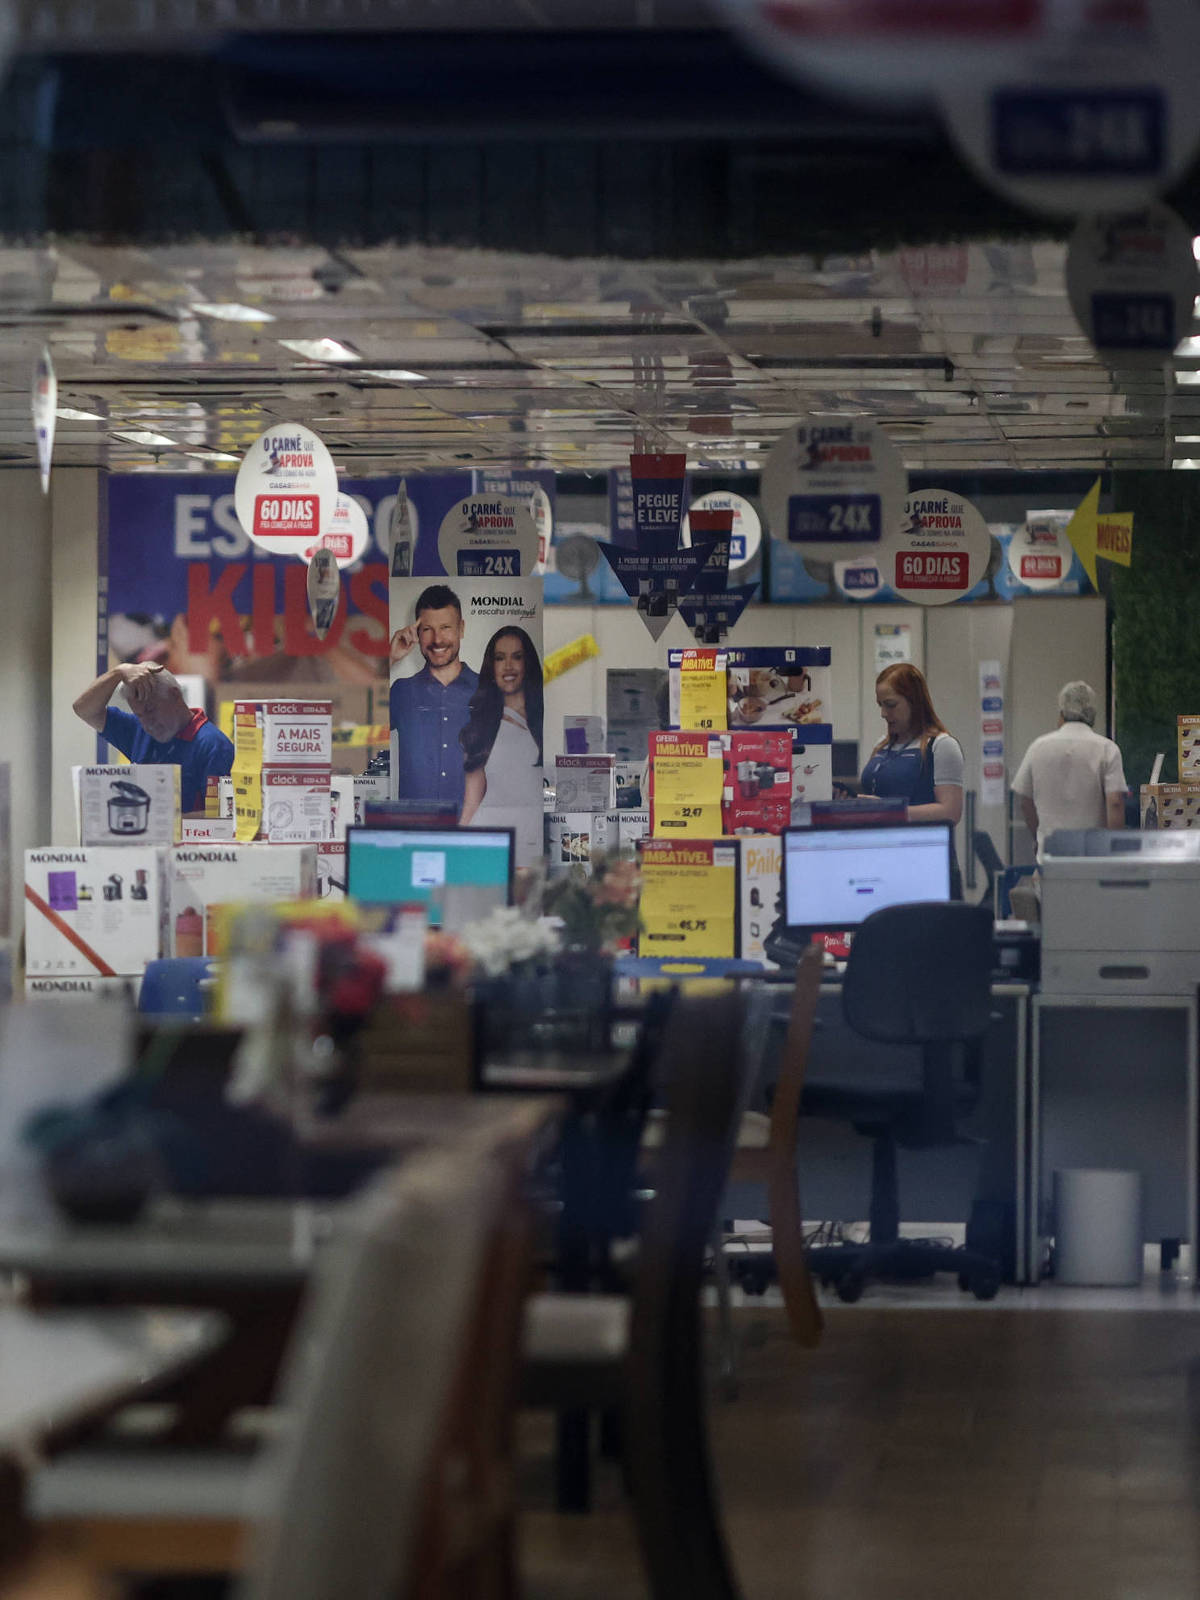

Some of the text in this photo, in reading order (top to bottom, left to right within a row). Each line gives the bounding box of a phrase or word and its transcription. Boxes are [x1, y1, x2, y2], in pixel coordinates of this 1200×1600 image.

[263, 437, 270, 452] O
[272, 433, 302, 452] CARNÊ
[279, 454, 313, 468] APROVA
[462, 503, 469, 515] O
[471, 500, 502, 515] CARNÊ
[637, 494, 679, 508] PEGUE
[913, 498, 949, 514] CARNÊ
[950, 505, 965, 514] QUE
[260, 500, 280, 520] 60
[281, 500, 313, 520] DIAS
[637, 509, 679, 523] E LEVE
[478, 516, 514, 528] APROVA
[829, 504, 872, 532] 24X
[921, 515, 962, 529] APROVA
[485, 556, 515, 575] 24X
[902, 556, 961, 574] 60 DIAS
[470, 596, 524, 606] MONDIAL
[187, 562, 392, 657] KIDS
[477, 607, 505, 615] escolha
[682, 656, 715, 671] IMBATÍVEL
[271, 703, 298, 714] clock
[277, 728, 321, 740] A MAIS
[276, 742, 322, 753] SEGURA
[656, 740, 706, 756] IMBATÍVEL
[558, 757, 581, 767] clock
[85, 767, 132, 776] MONDIAL
[271, 775, 298, 785] clock
[30, 852, 88, 864] MONDIAL
[175, 851, 238, 863] MONDIAL
[643, 847, 711, 864] IMBATÍVEL
[31, 981, 94, 992] MONDIAL
